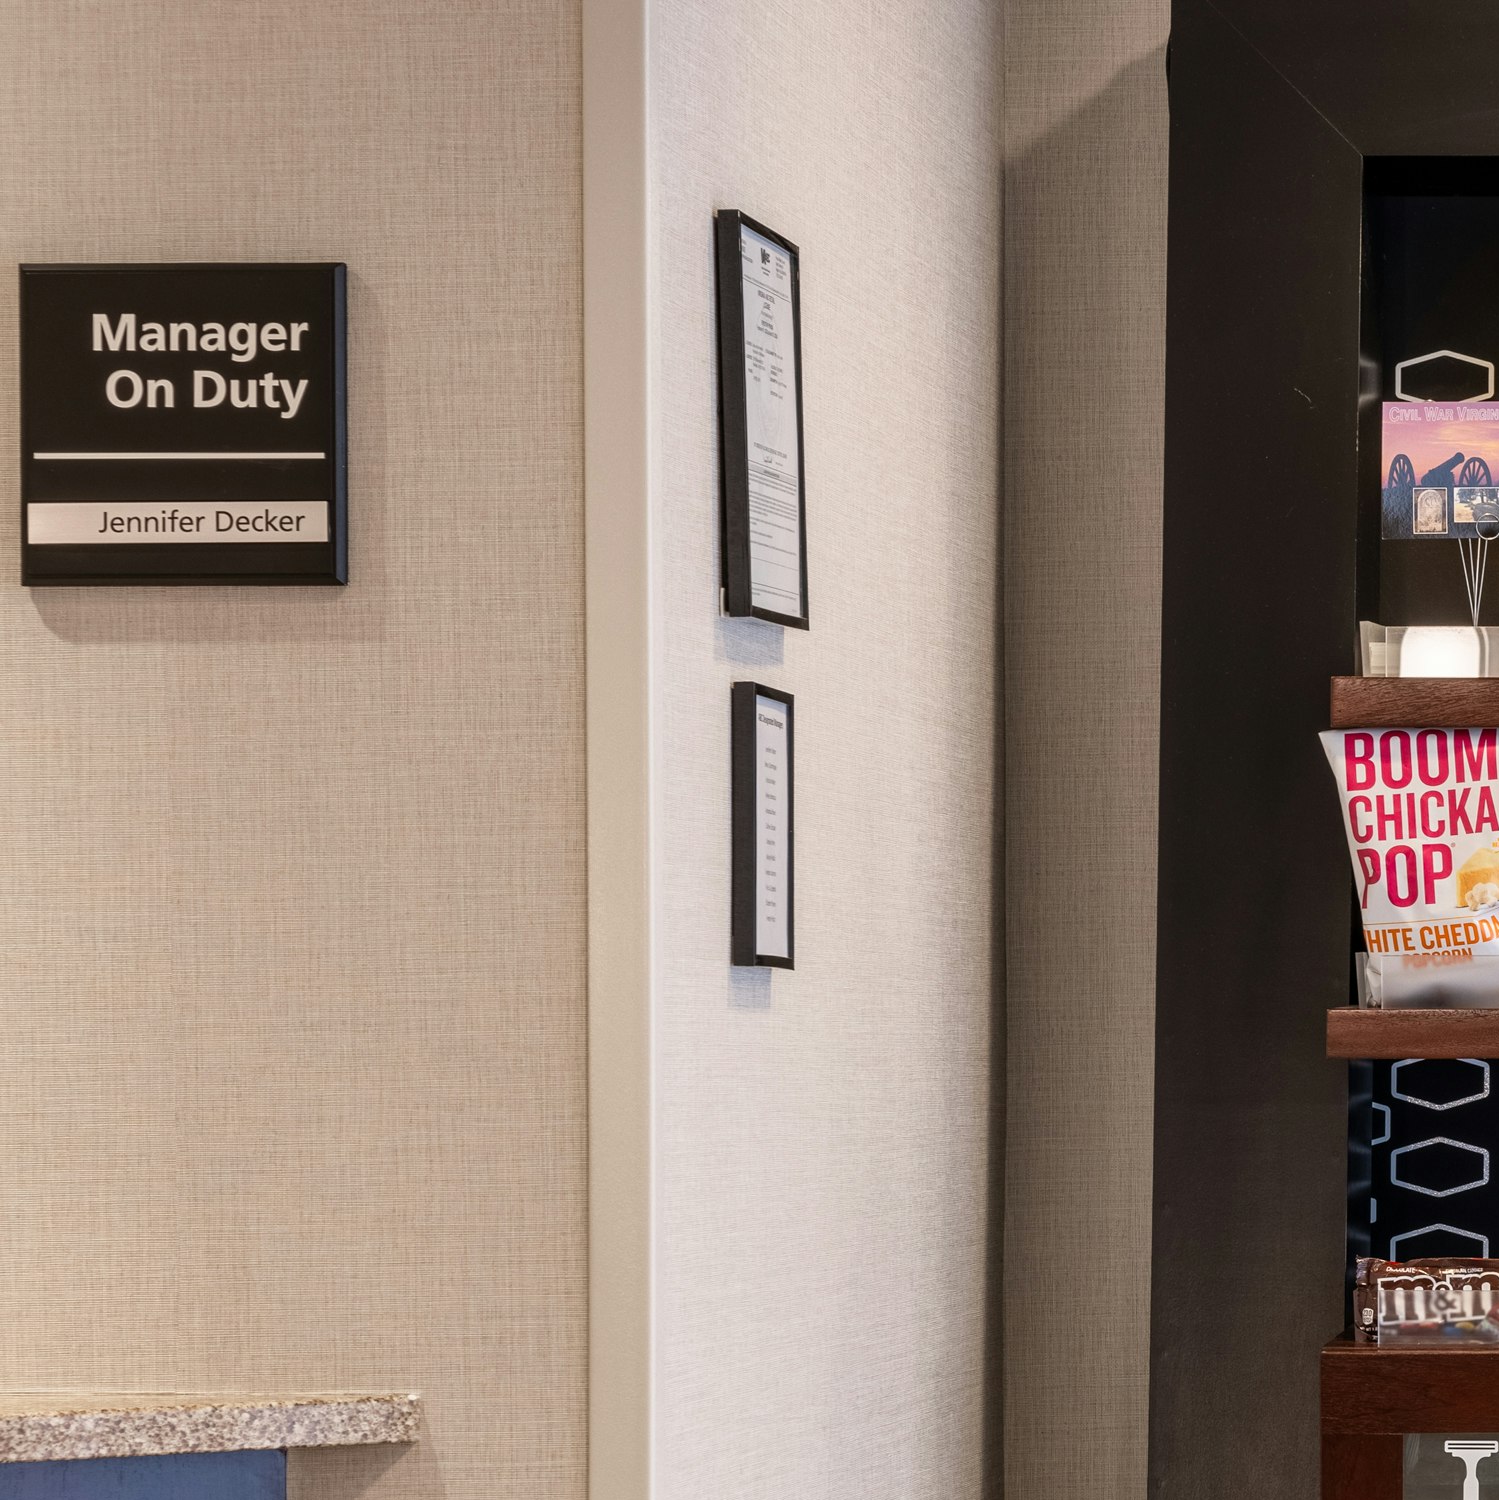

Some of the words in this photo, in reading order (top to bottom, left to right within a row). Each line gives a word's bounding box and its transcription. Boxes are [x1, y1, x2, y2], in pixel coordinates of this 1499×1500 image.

[92, 313, 309, 362] Manager
[105, 369, 175, 408] On
[193, 369, 309, 419] Duty
[1389, 406, 1421, 422] CIVIL
[1424, 407, 1454, 421] WAR
[98, 509, 205, 533] Jennifer
[215, 509, 305, 532] Decker
[1344, 729, 1499, 792] BOOM
[1348, 785, 1499, 844] CHICKA
[1357, 843, 1454, 909] POP
[1363, 927, 1416, 953] HITE
